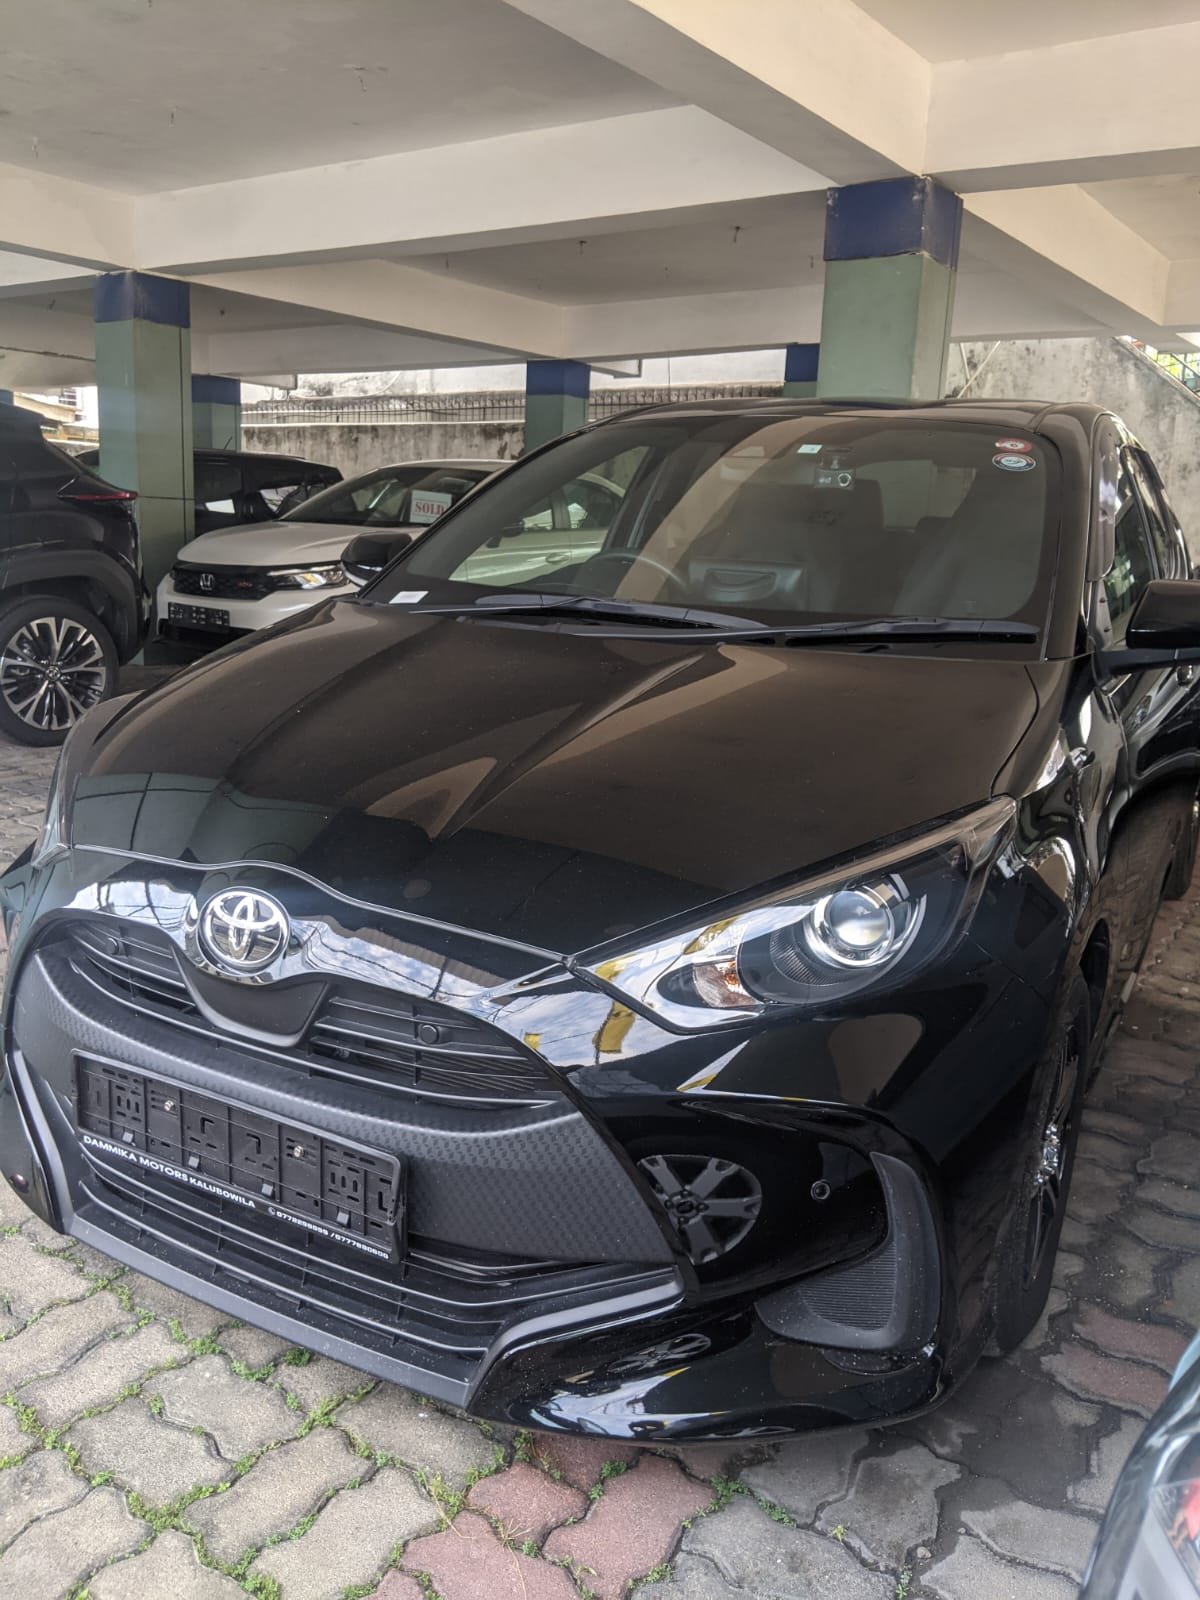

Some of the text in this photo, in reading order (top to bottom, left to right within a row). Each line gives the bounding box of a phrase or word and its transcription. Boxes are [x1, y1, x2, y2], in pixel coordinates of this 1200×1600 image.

[415, 501, 445, 515] SOLD
[83, 1135, 137, 1162] DAMMIKA
[139, 1156, 188, 1182] MOTORS
[189, 1176, 256, 1208] KALUBOWILA
